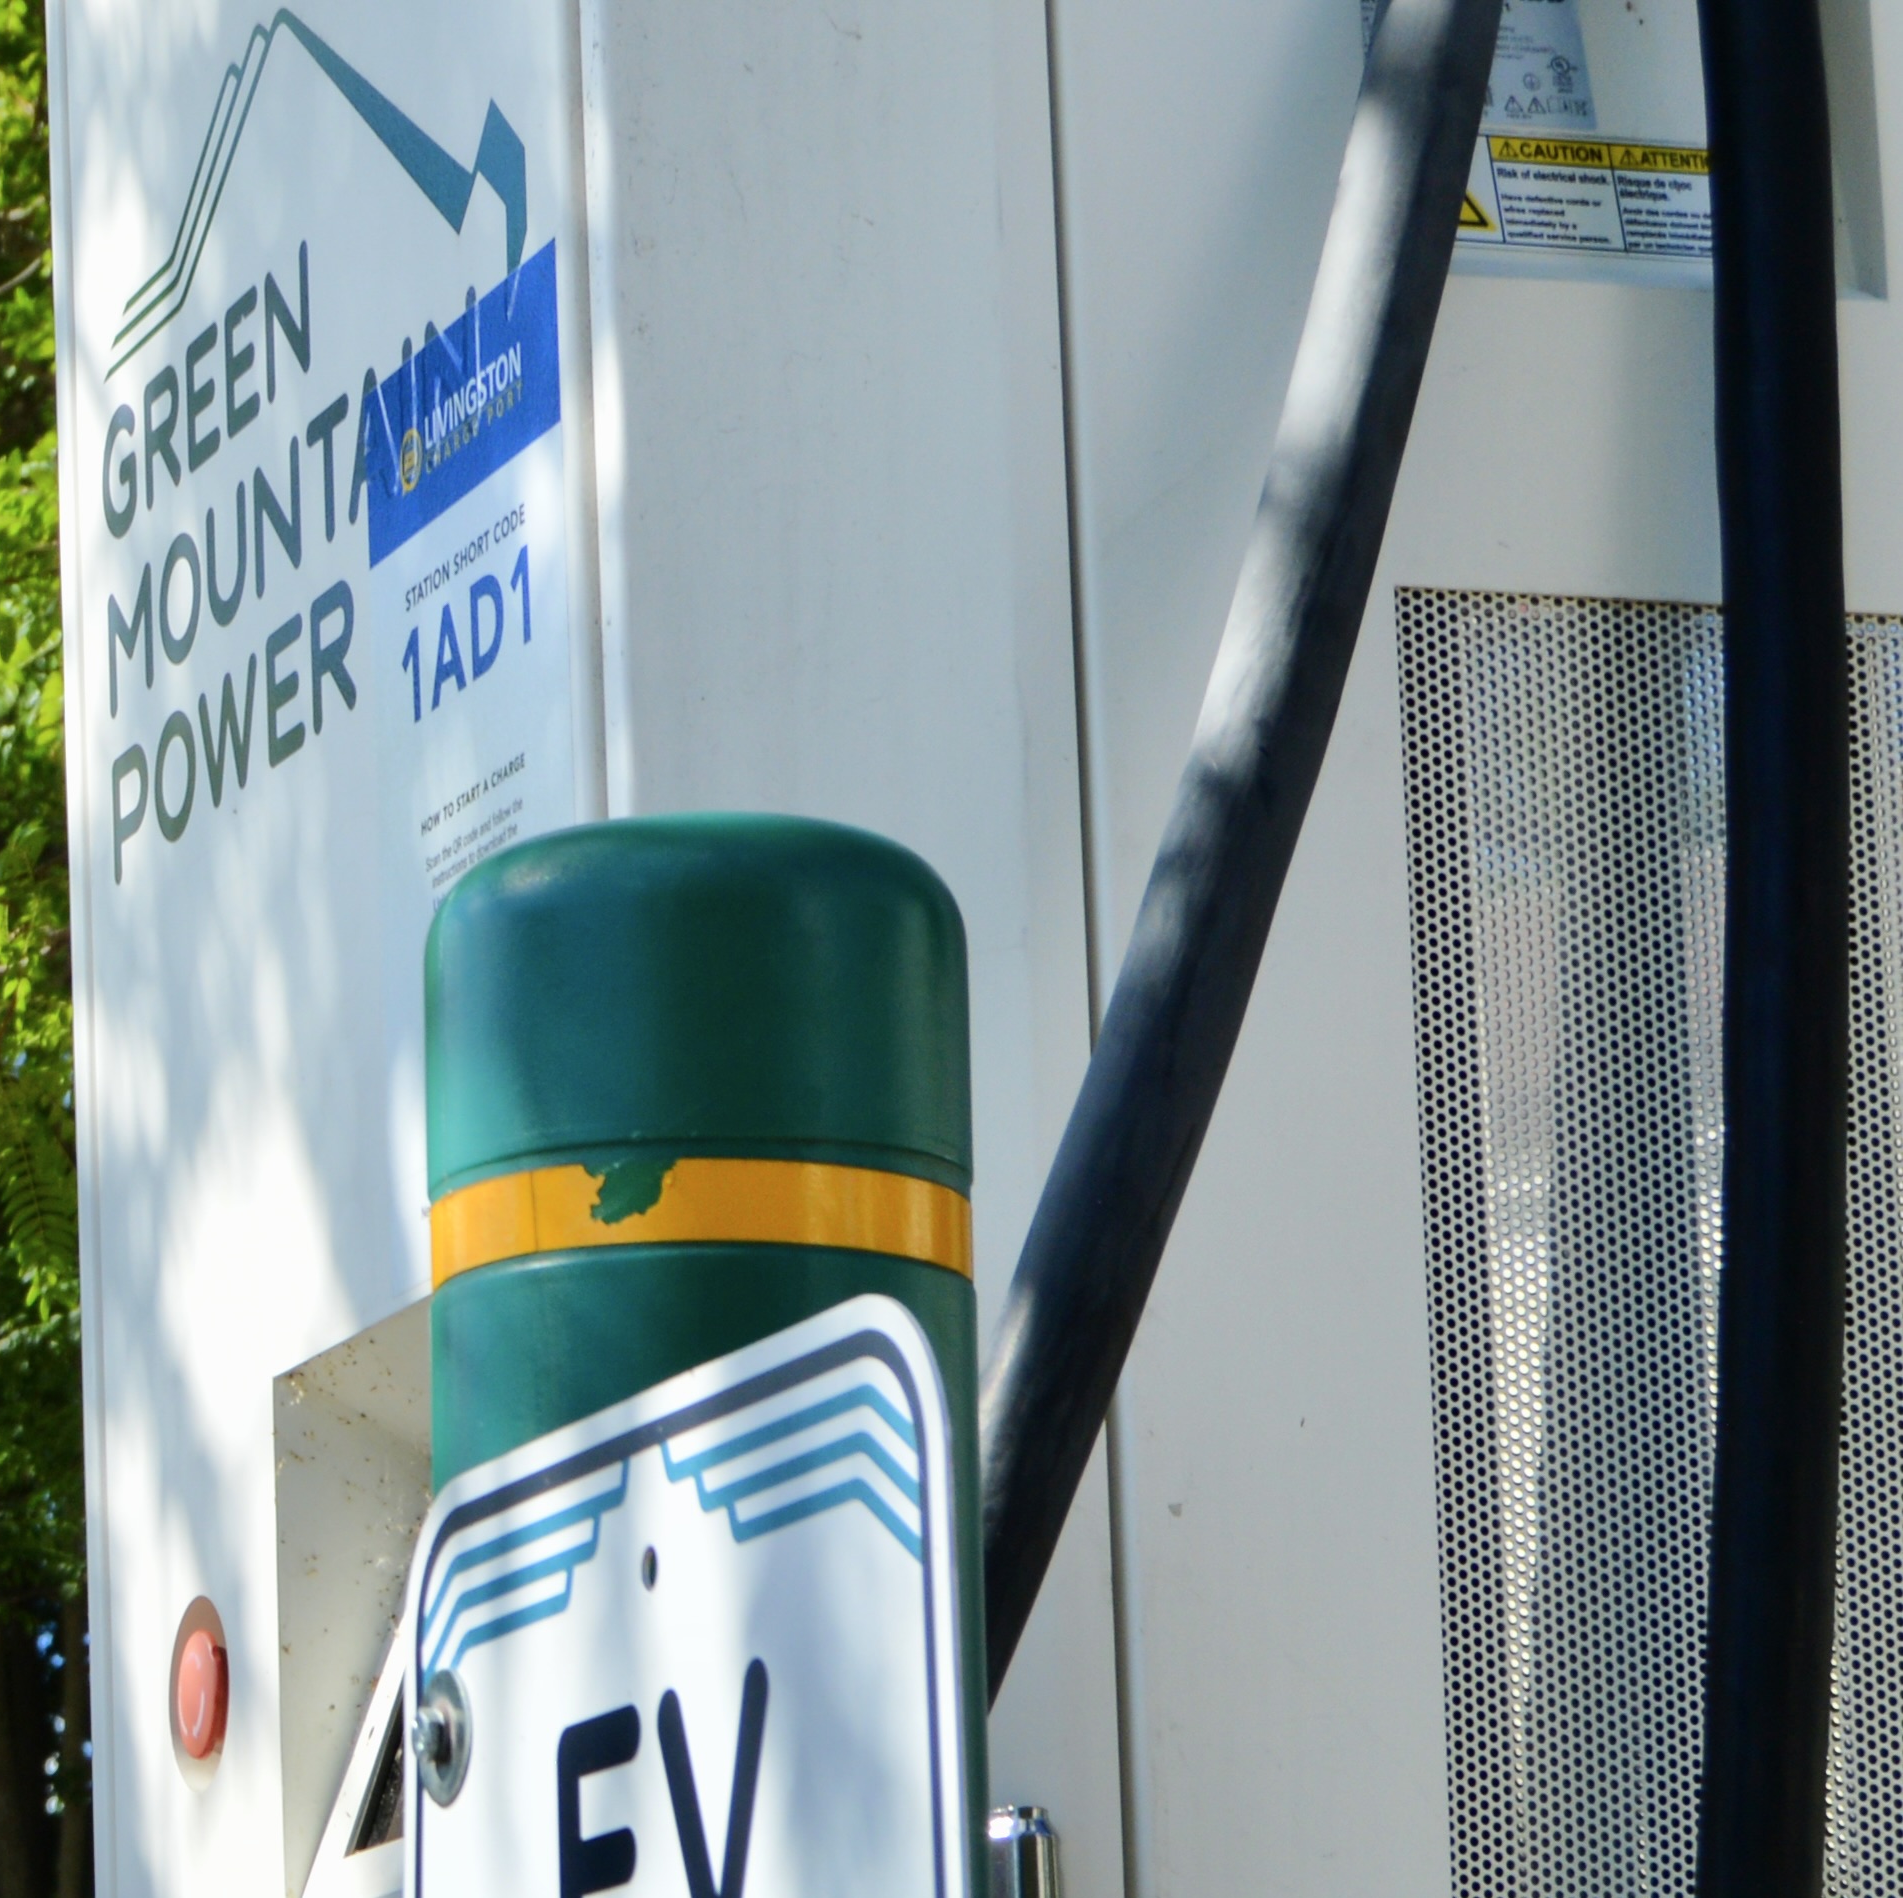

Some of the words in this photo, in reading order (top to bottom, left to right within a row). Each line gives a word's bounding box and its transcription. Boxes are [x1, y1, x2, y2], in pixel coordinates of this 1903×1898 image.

[1496, 167, 1518, 178] Risk
[1521, 169, 1530, 178] of
[1533, 170, 1576, 183] electrical
[1520, 142, 1604, 162] CAUTION
[1617, 175, 1651, 189] Risque
[1653, 178, 1666, 188] de
[104, 240, 310, 540] GREEN
[424, 342, 522, 450] LIVINGSTON
[405, 560, 451, 613] STATION
[453, 530, 490, 576] SHORT
[493, 503, 526, 545] CODE
[401, 543, 532, 724] 1AD1
[112, 577, 356, 885] POWER
[420, 809, 442, 837] HOW
[442, 801, 454, 821] TO
[456, 783, 481, 813] START
[482, 778, 489, 794] A
[491, 752, 525, 789] CHARGE
